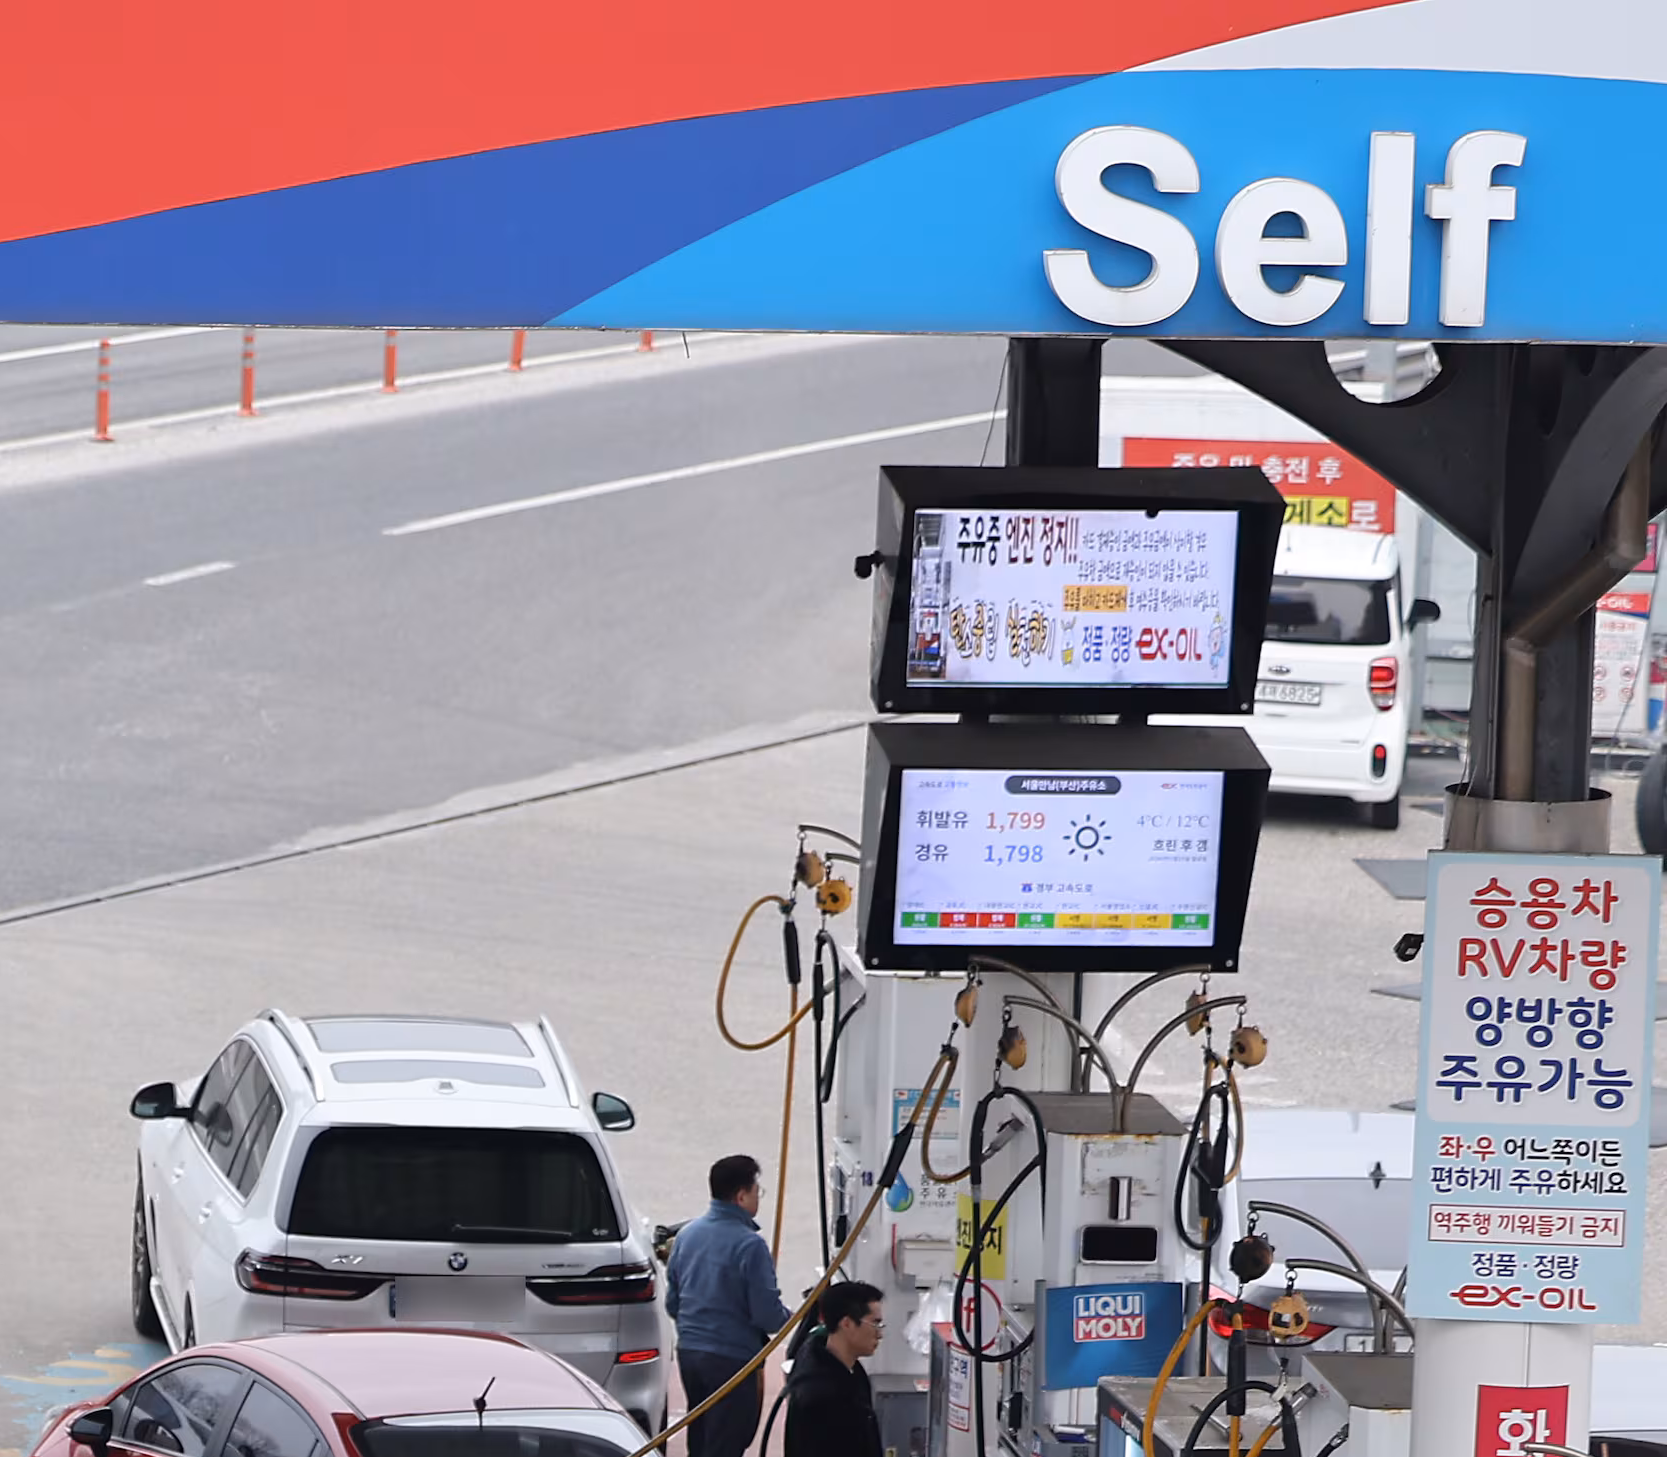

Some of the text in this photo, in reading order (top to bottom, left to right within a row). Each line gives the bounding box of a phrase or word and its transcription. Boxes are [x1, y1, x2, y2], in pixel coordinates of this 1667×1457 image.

[1042, 125, 1527, 327] Self
[1262, 455, 1309, 484] 충전
[1316, 457, 1343, 485] 후
[1284, 499, 1381, 531] 게소로
[957, 516, 1001, 567] 주유중
[1006, 515, 1035, 564] 엔진
[1082, 626, 1132, 663] 정품 정량
[917, 810, 1046, 833] 휘발유 1,799
[915, 844, 1044, 866] 경유 1,798
[1153, 839, 1176, 852] 흐린
[1180, 839, 1192, 852] 후
[1470, 877, 1619, 930] 승용차
[1458, 937, 1627, 990] RV차량
[1466, 996, 1614, 1050] 양방향
[1436, 1055, 1633, 1110] 주유가능
[1504, 1138, 1622, 1167] 어느쪽이든
[1431, 1167, 1628, 1195] 편하게 주유하세요
[1434, 1212, 1619, 1239] 역주행 끼워들기 금지
[1472, 1253, 1579, 1279] 정품 정량
[1078, 1295, 1140, 1317] LIQUI
[1078, 1317, 1142, 1339] MOLY
